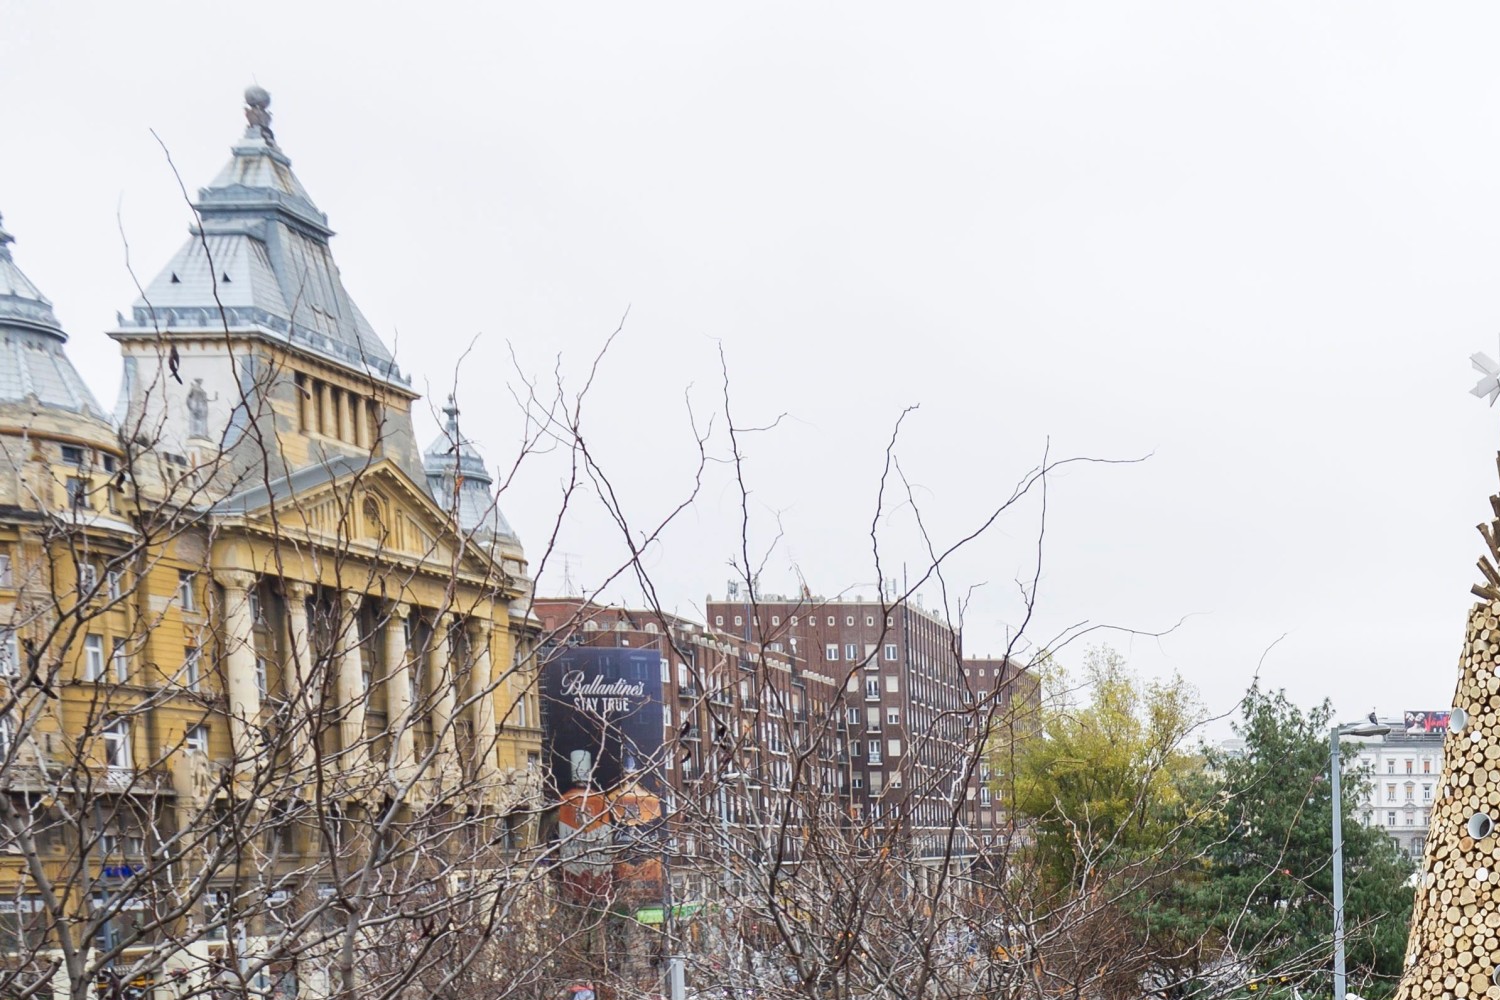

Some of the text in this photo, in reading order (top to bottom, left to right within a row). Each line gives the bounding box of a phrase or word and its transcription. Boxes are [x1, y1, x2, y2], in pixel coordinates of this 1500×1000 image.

[561, 669, 645, 697] Ballantine's
[574, 697, 630, 712] STAY TRUE
